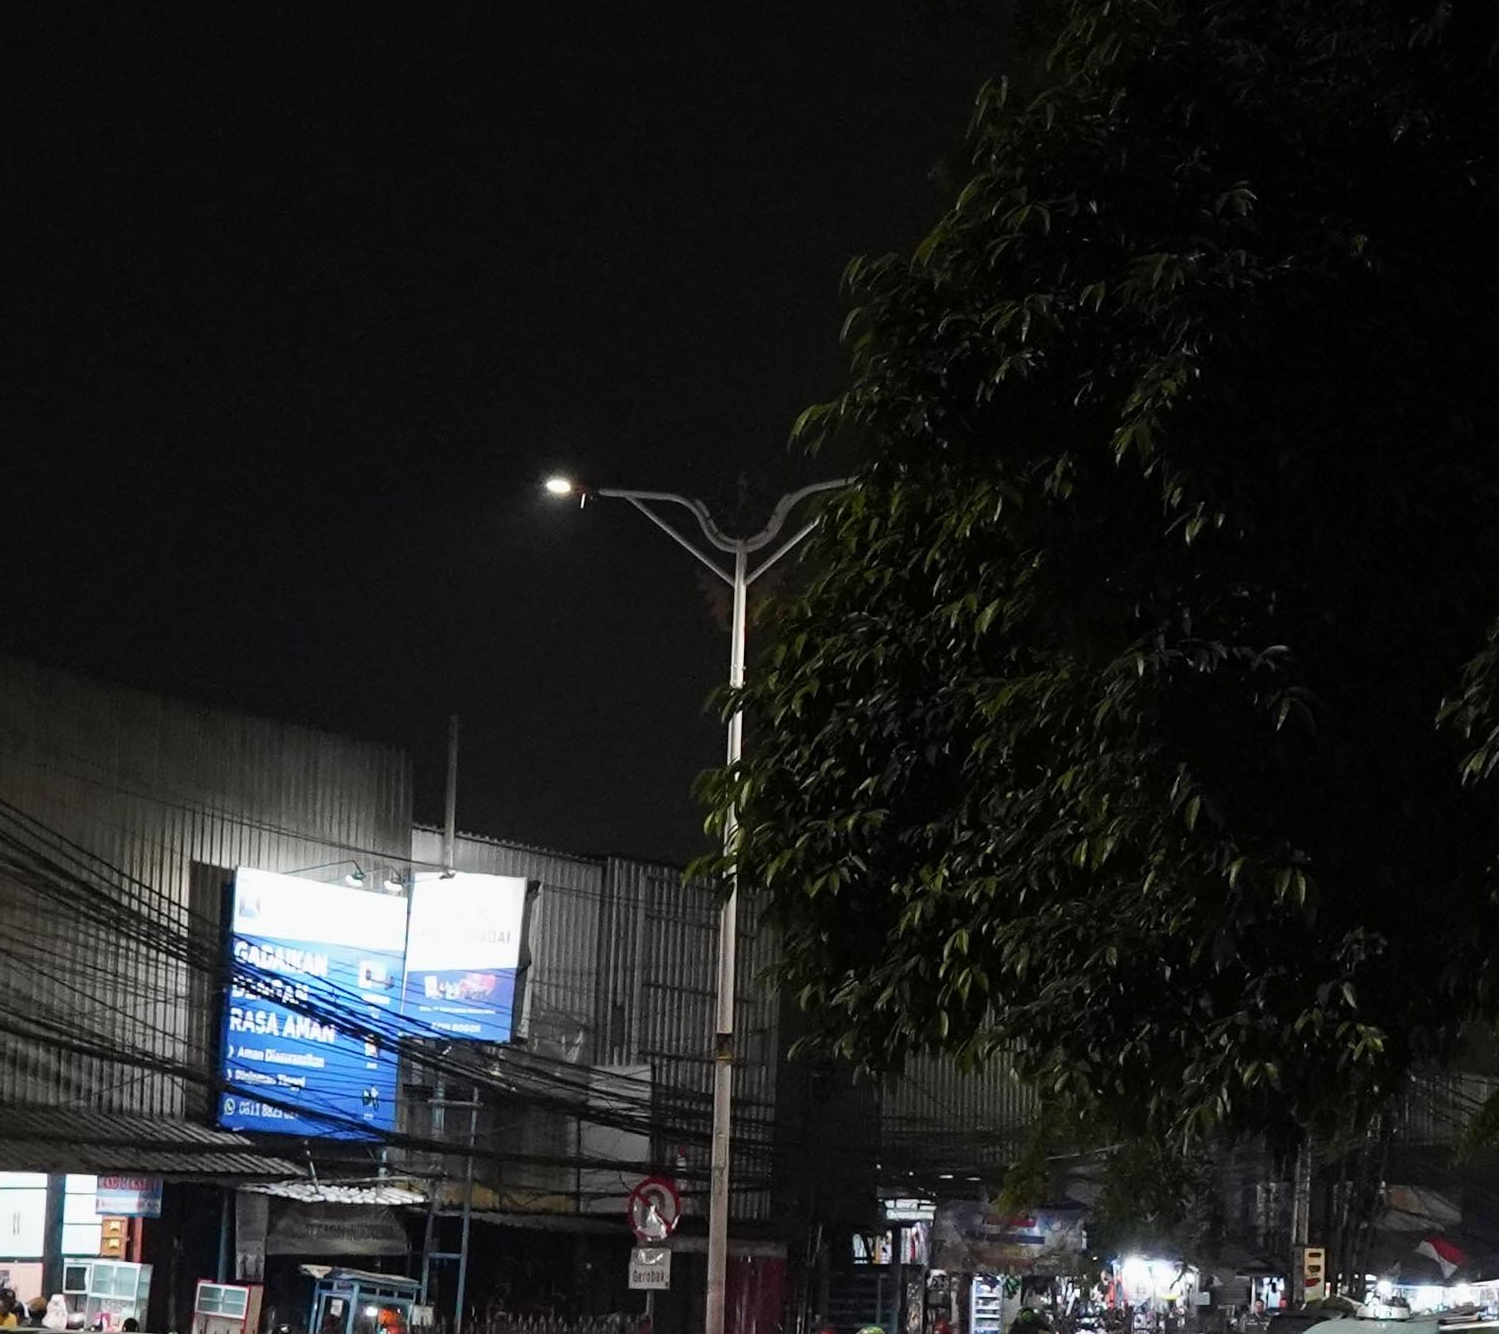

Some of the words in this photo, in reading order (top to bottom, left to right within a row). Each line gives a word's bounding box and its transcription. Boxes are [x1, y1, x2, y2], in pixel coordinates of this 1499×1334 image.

[234, 941, 329, 977] GADAIKAN
[230, 1007, 279, 1037] RASA
[282, 1014, 336, 1044] AMAN
